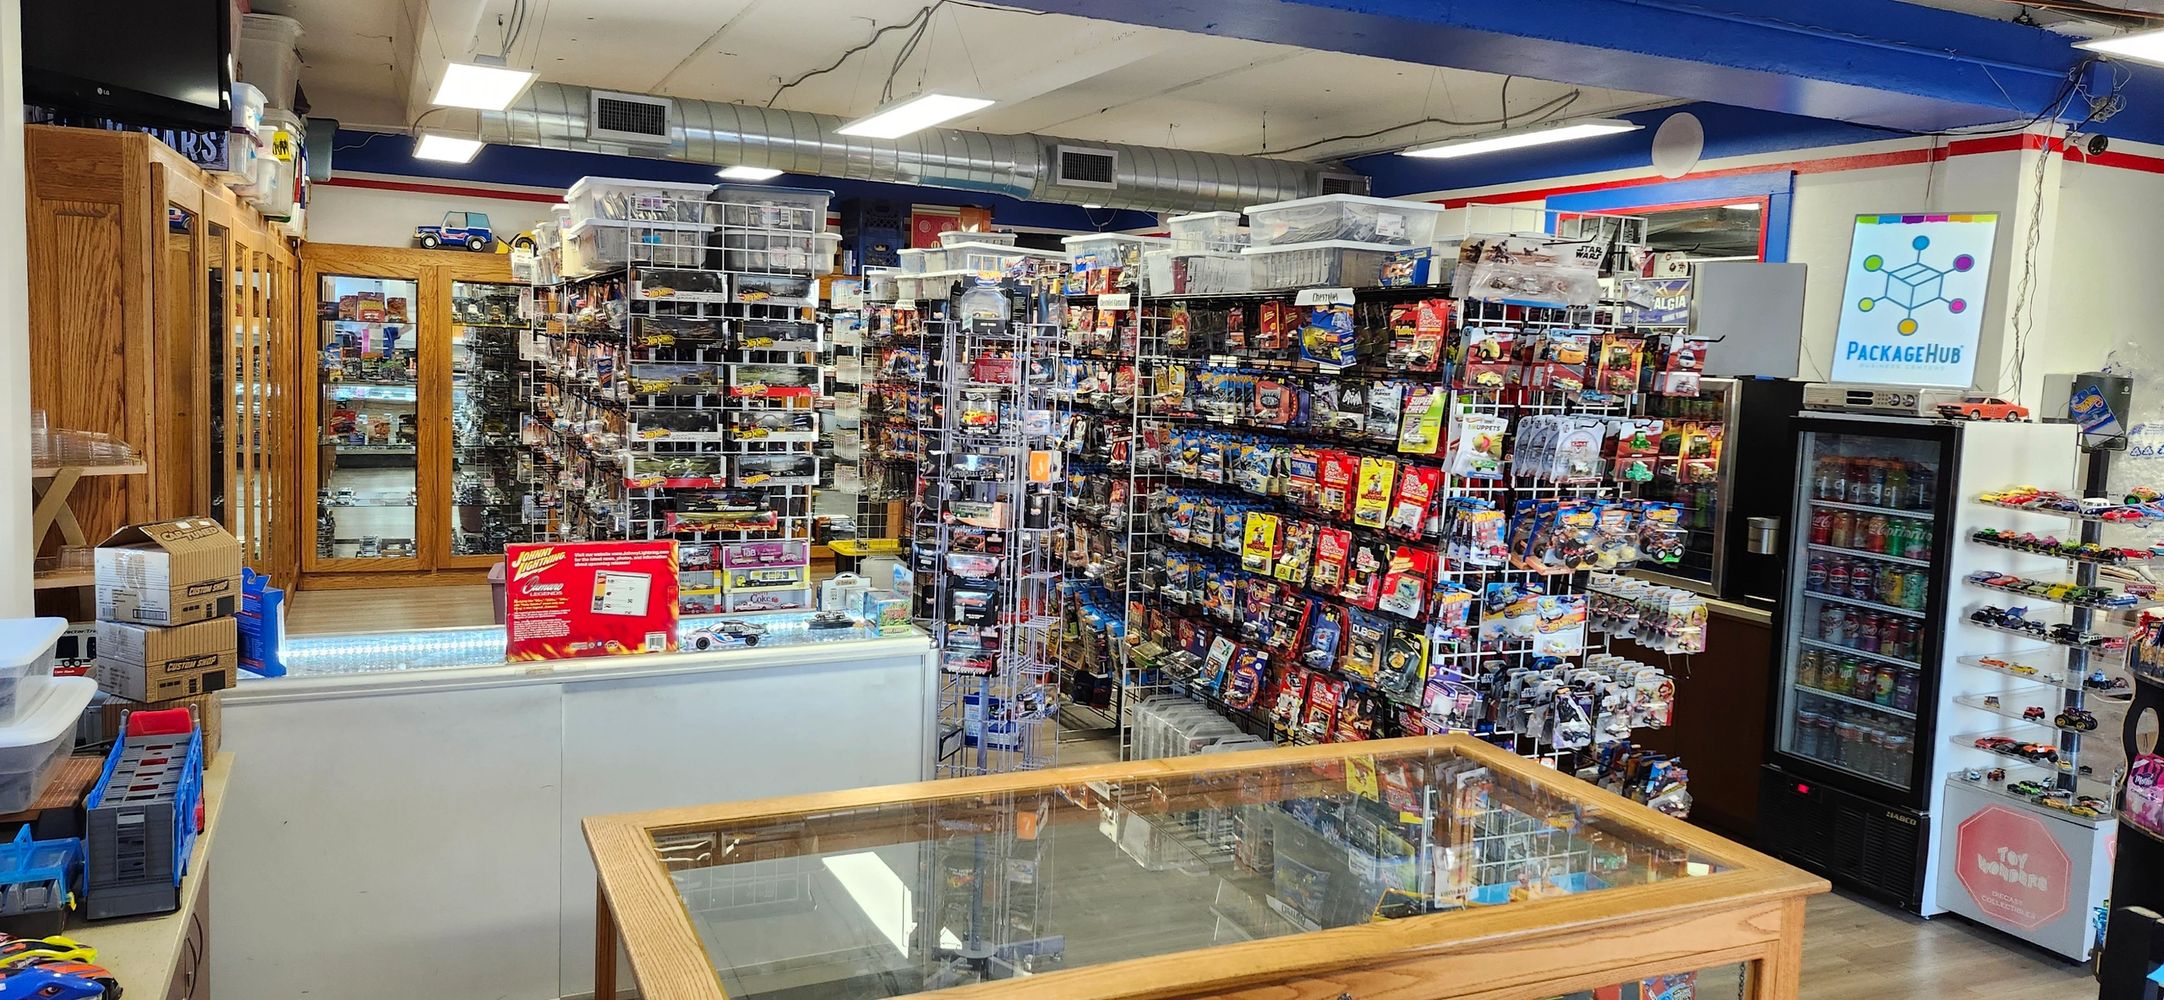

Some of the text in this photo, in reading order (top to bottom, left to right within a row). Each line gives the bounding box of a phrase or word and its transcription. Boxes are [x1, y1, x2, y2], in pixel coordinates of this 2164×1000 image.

[1575, 252, 1602, 260] WARS
[1580, 245, 1602, 254] STAR
[1411, 396, 1434, 405] SUPER
[512, 547, 554, 568] JOHNNY
[518, 552, 566, 574] LIGHTNING
[188, 580, 229, 597] CUSTOM SHOP
[1352, 623, 1367, 634] DUB
[166, 656, 218, 672] CUSTOM SHOP
[1997, 846, 2028, 870] TOY
[1977, 853, 2049, 892] WONDERS
